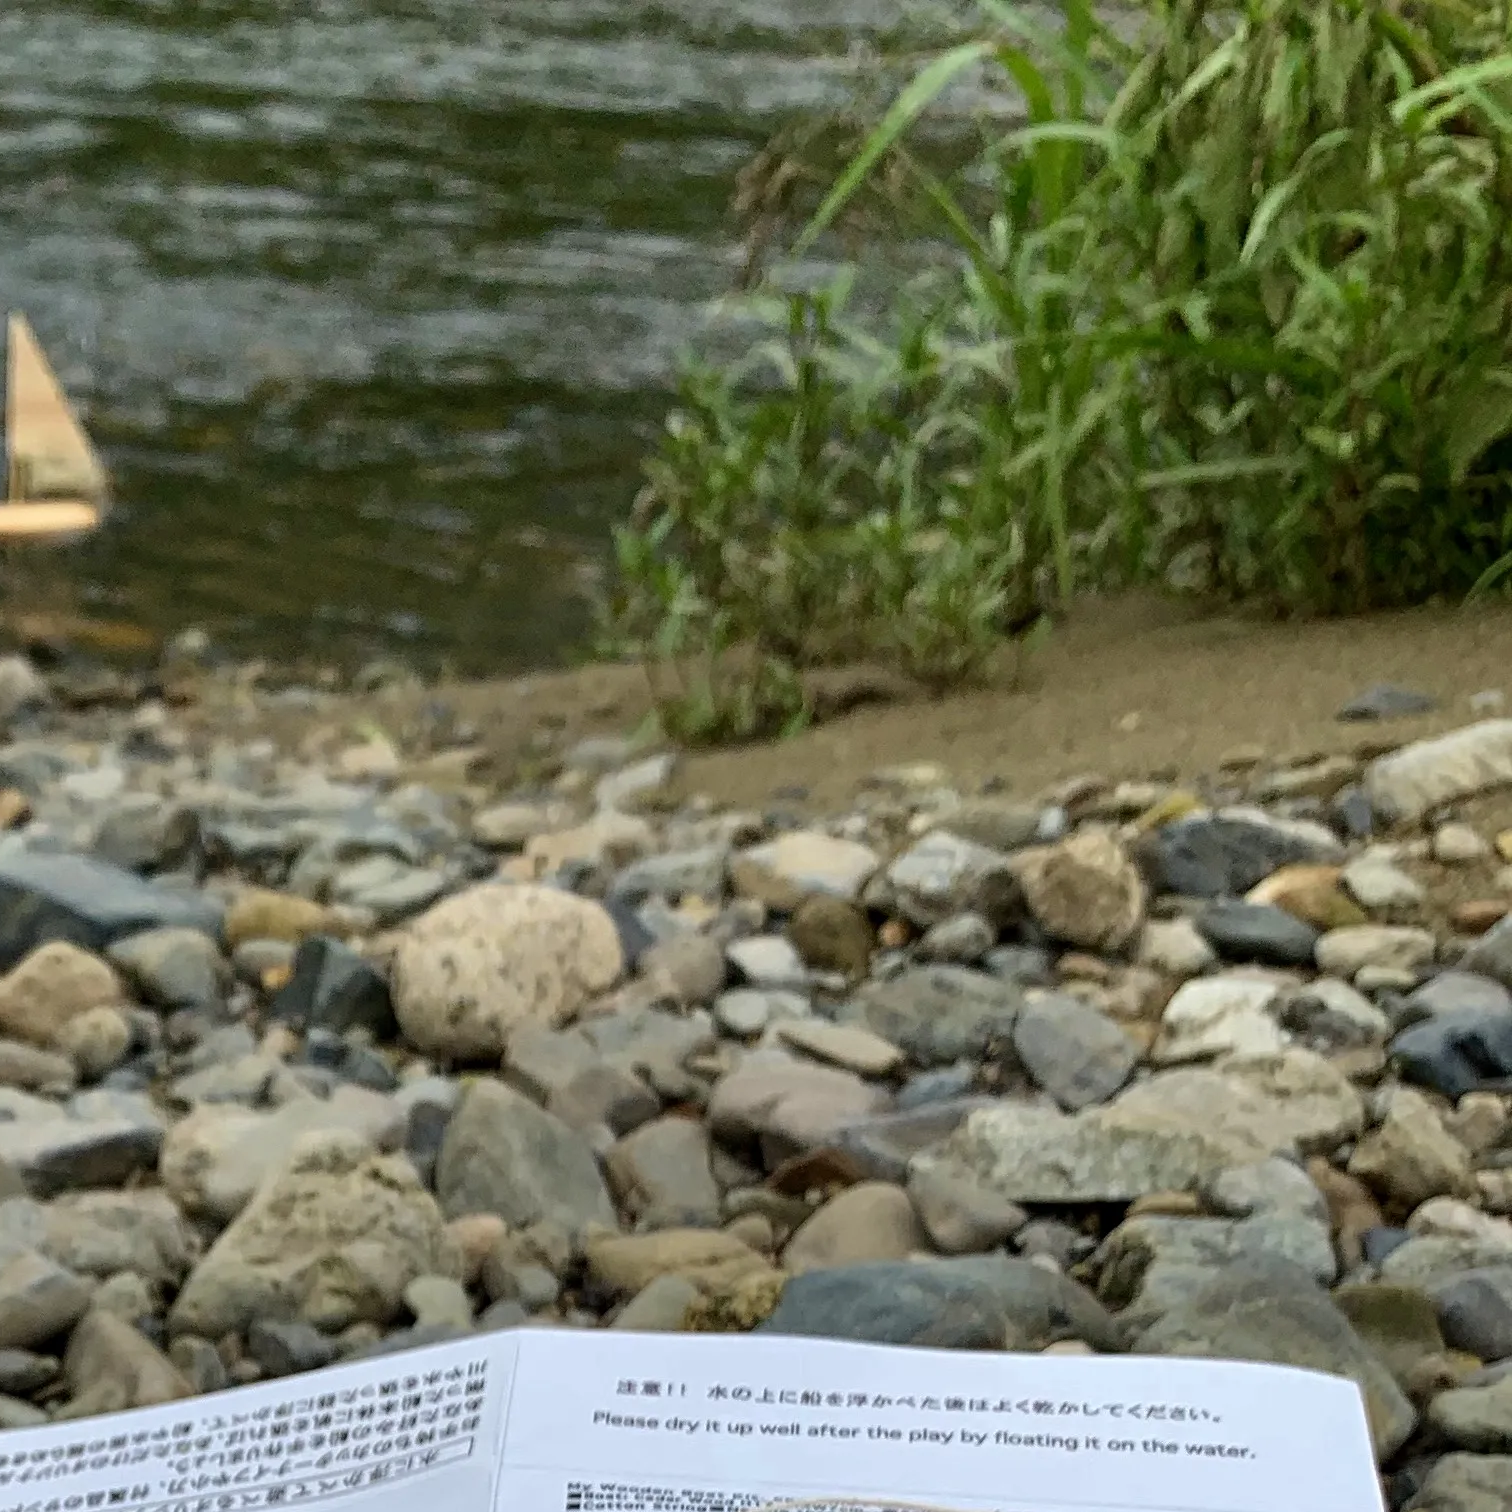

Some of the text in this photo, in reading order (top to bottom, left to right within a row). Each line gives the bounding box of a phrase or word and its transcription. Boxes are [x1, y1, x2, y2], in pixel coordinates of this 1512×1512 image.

[592, 1410, 1256, 1459] Please dry it up well after the play by floating it on the water.
